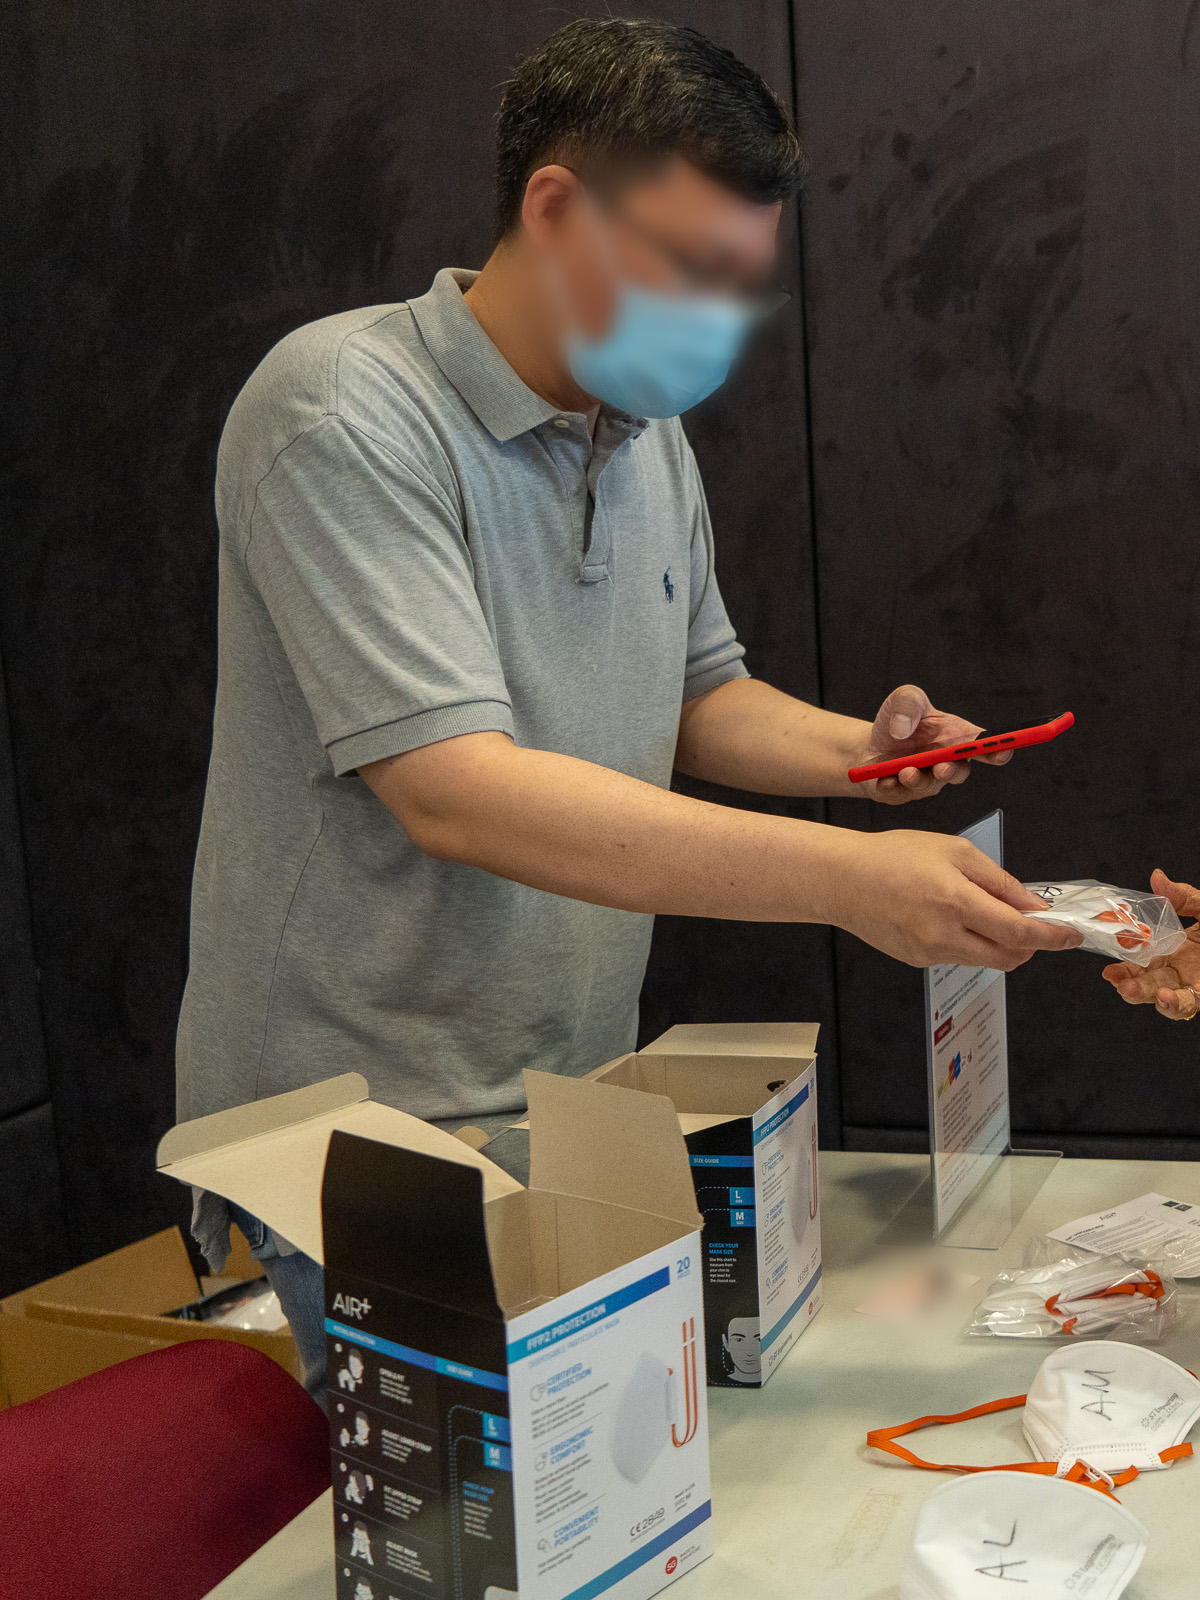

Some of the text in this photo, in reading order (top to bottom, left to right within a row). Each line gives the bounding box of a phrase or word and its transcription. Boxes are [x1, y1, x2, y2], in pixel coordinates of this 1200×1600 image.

[735, 1190, 741, 1199] L
[735, 1212, 744, 1220] M
[676, 1256, 691, 1274] 20
[332, 1292, 372, 1320] AIR+
[551, 1303, 607, 1340] PROTECTION
[1080, 1368, 1117, 1421] AM
[488, 1417, 496, 1432] L
[553, 1505, 599, 1538] CONVENIENT
[553, 1514, 599, 1548] PORTABILITY
[974, 1519, 1029, 1583] AL
